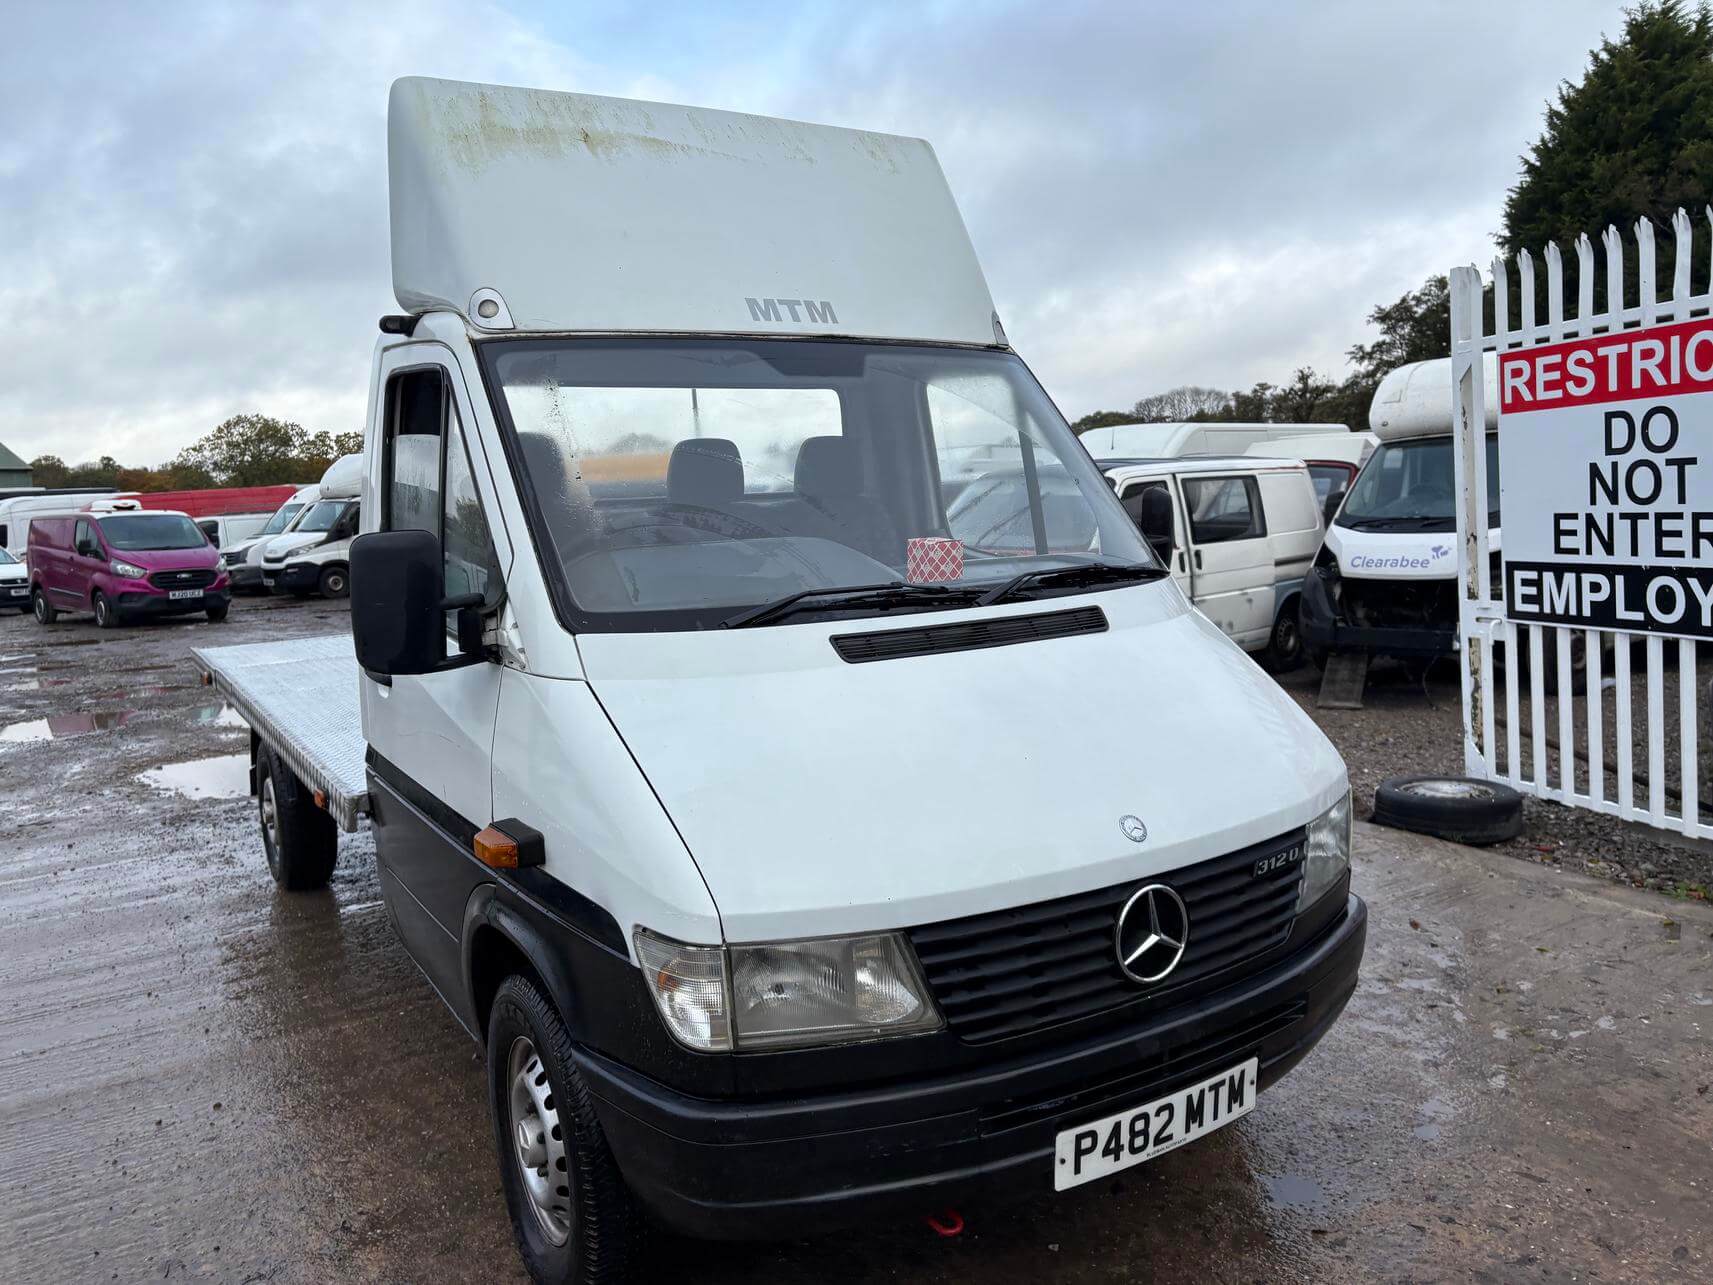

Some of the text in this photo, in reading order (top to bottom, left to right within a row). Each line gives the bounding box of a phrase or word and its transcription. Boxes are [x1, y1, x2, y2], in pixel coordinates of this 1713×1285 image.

[744, 297, 839, 324] MTM
[1604, 405, 1680, 456] DO
[1589, 457, 1699, 507] NOT
[1553, 511, 1713, 559] ENTER
[1350, 555, 1430, 569] Clearabee
[1512, 569, 1713, 627] EMPLOY
[1073, 1068, 1246, 1176] P482 MTM
